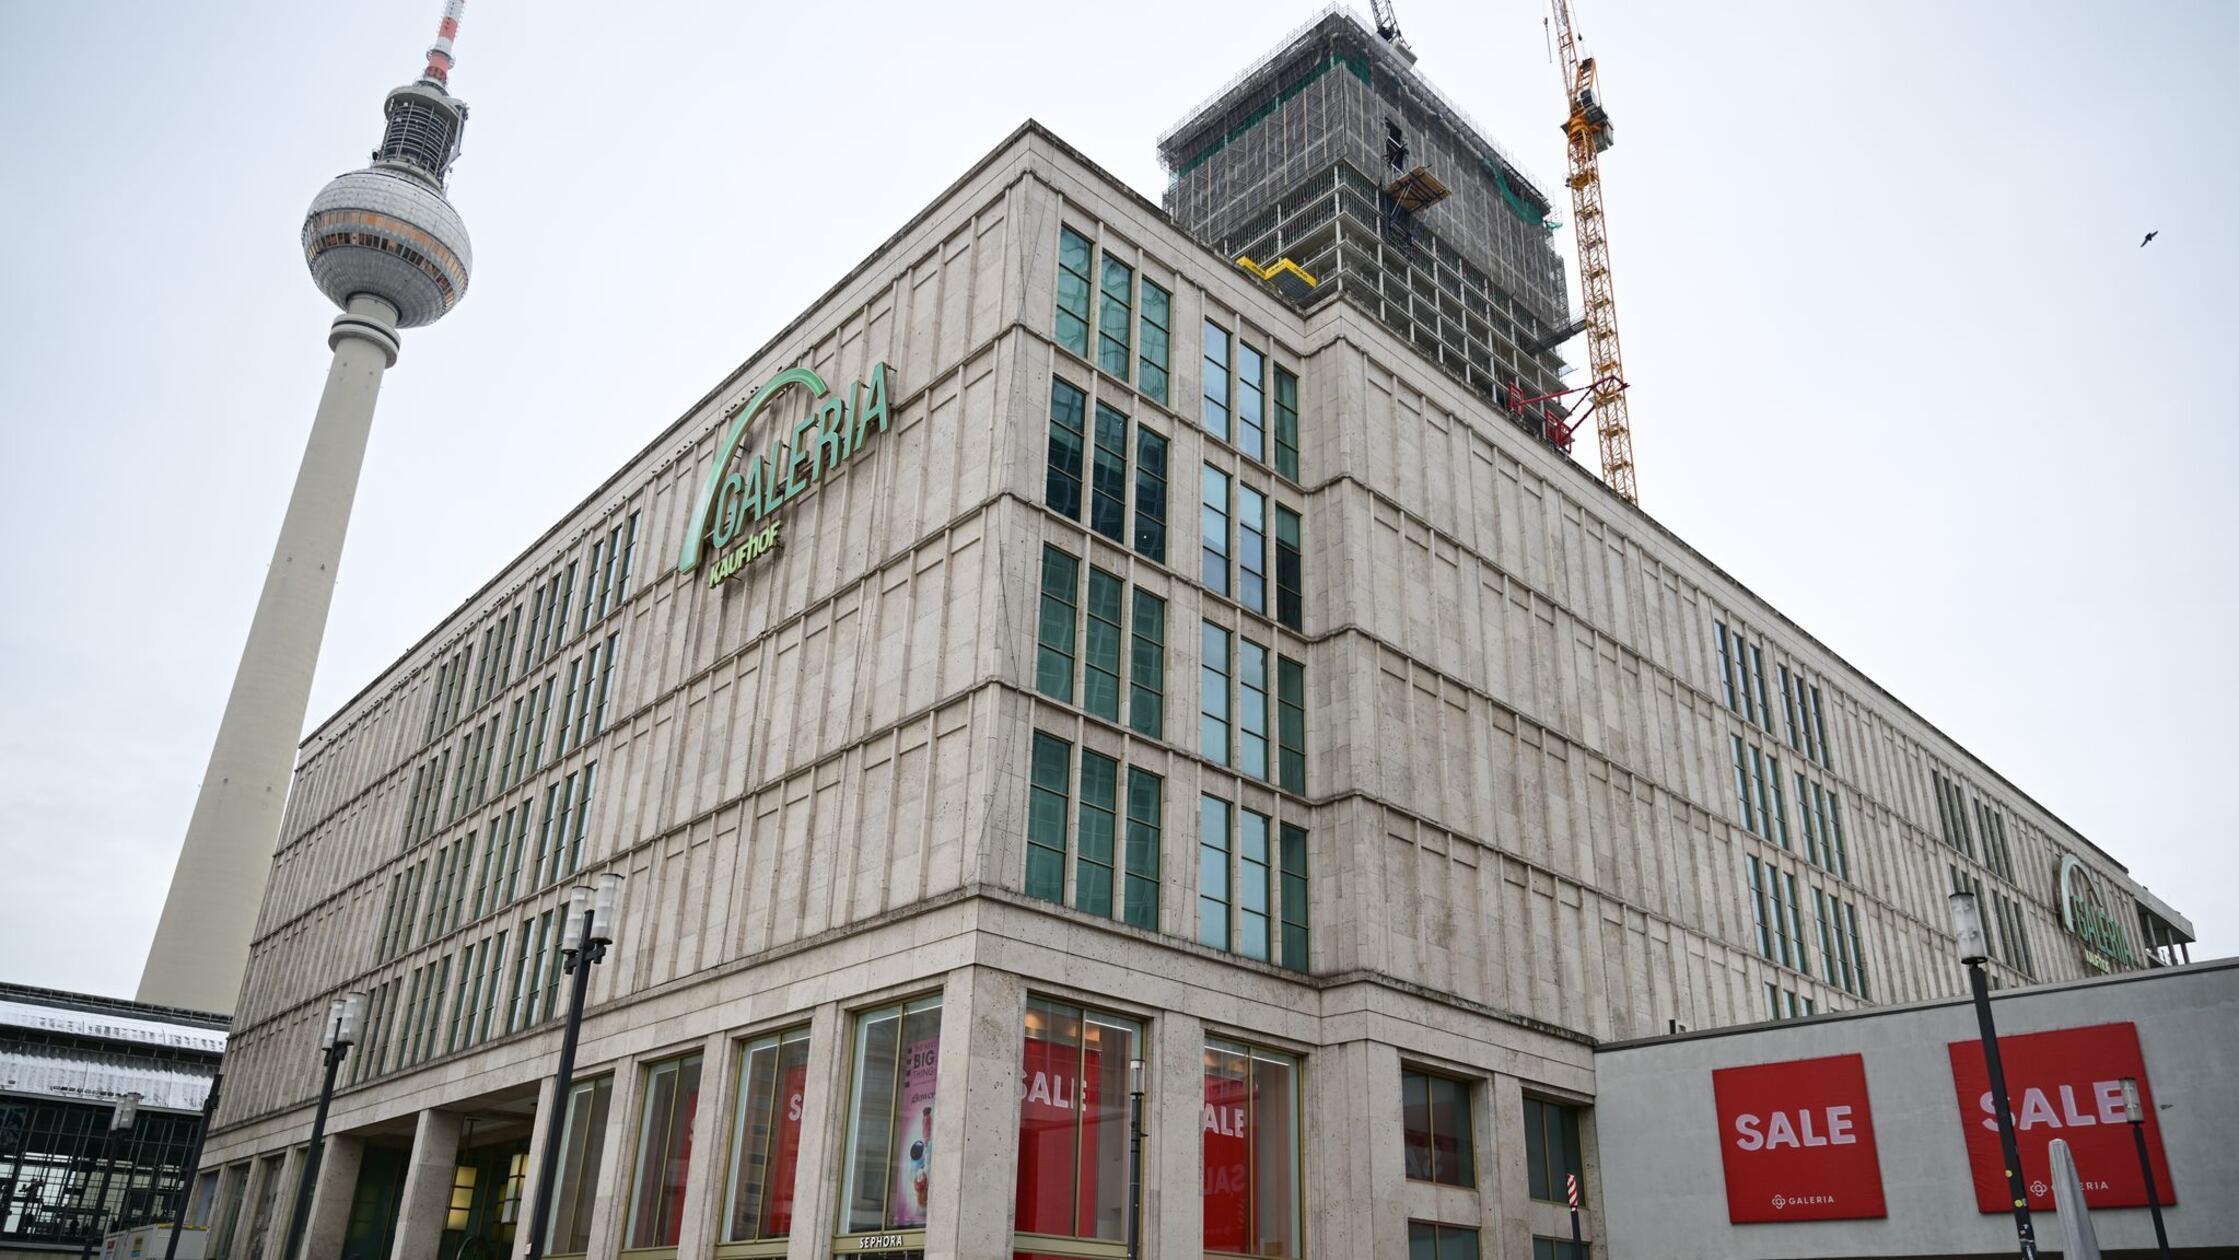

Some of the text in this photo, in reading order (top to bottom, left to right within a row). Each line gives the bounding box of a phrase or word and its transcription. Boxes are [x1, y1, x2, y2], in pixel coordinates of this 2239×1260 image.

[713, 361, 890, 550] GALERIA
[913, 1049, 935, 1069] BIG
[1735, 1105, 1857, 1152] SALE
[1788, 1195, 1835, 1205] GALERIA
[859, 1235, 903, 1249] SEPHORA
